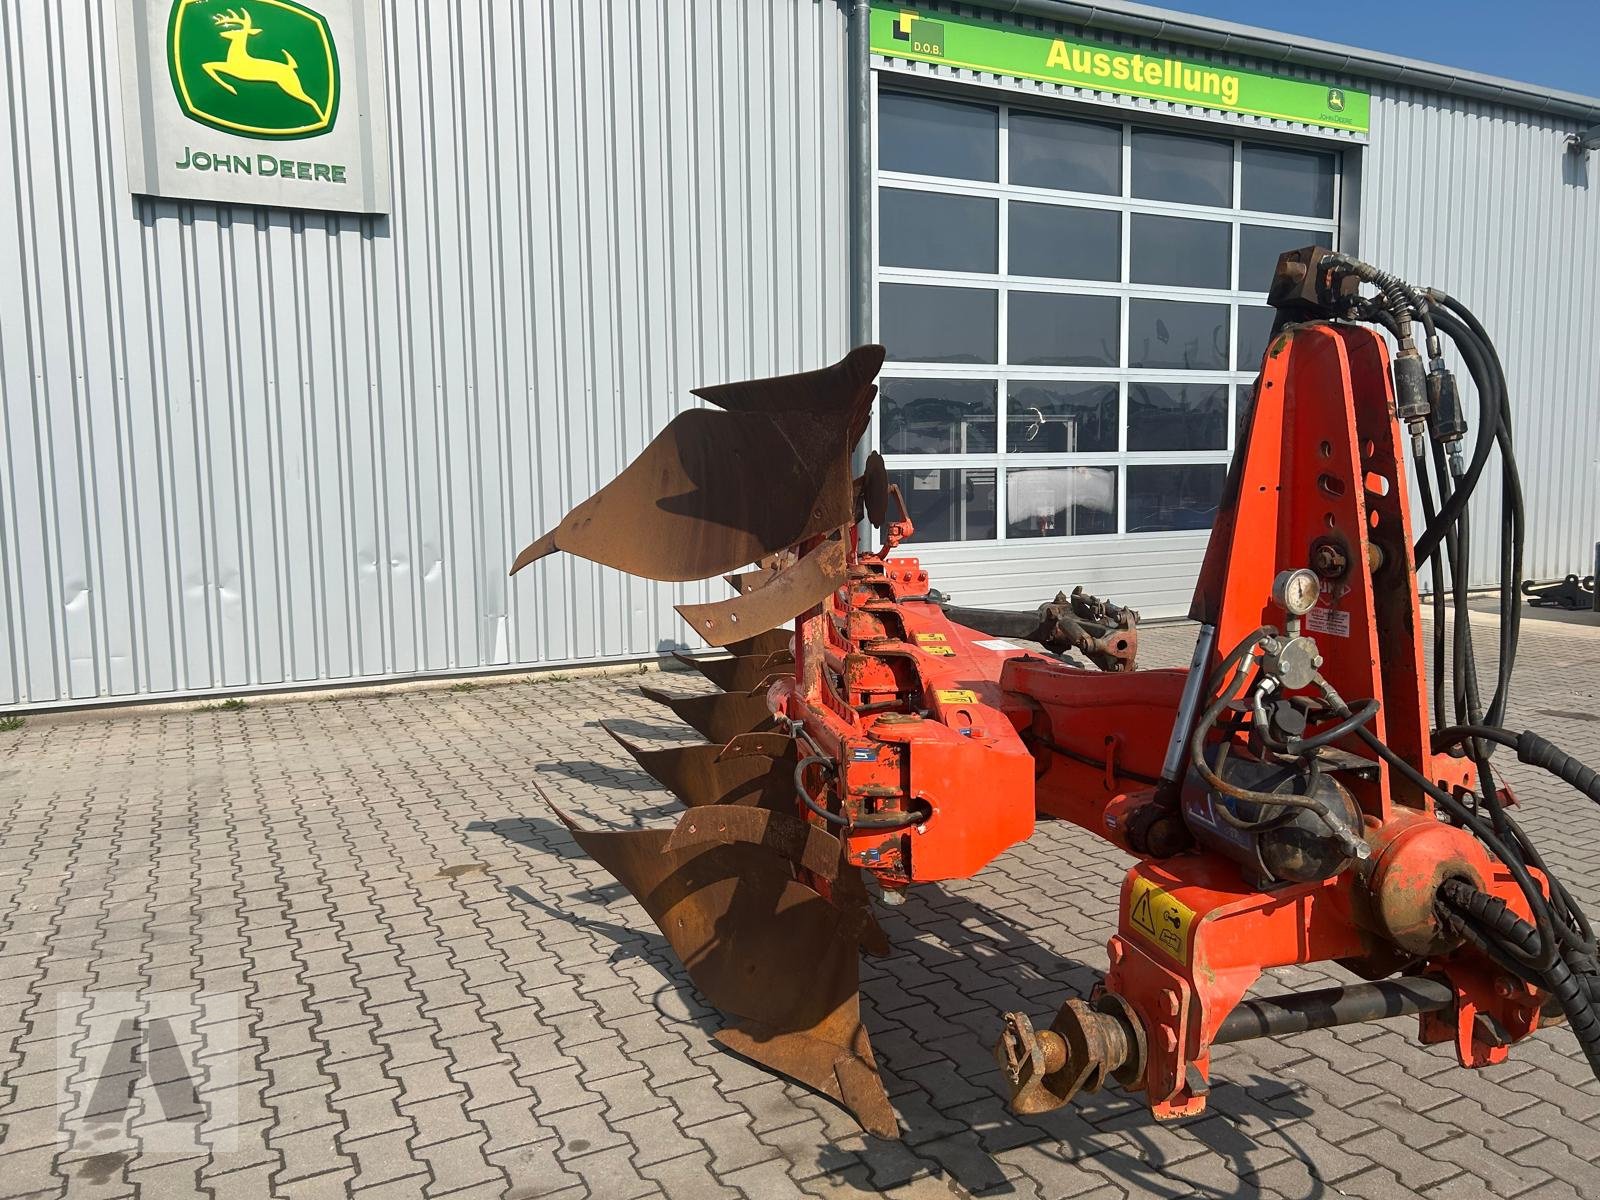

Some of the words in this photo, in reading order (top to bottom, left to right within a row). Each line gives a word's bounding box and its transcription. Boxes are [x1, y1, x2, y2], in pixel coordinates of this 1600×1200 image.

[914, 41, 942, 56] D.O.B.
[1045, 38, 1239, 106] Ausstellung
[175, 146, 252, 175] JOHN
[257, 154, 347, 184] DEERE
